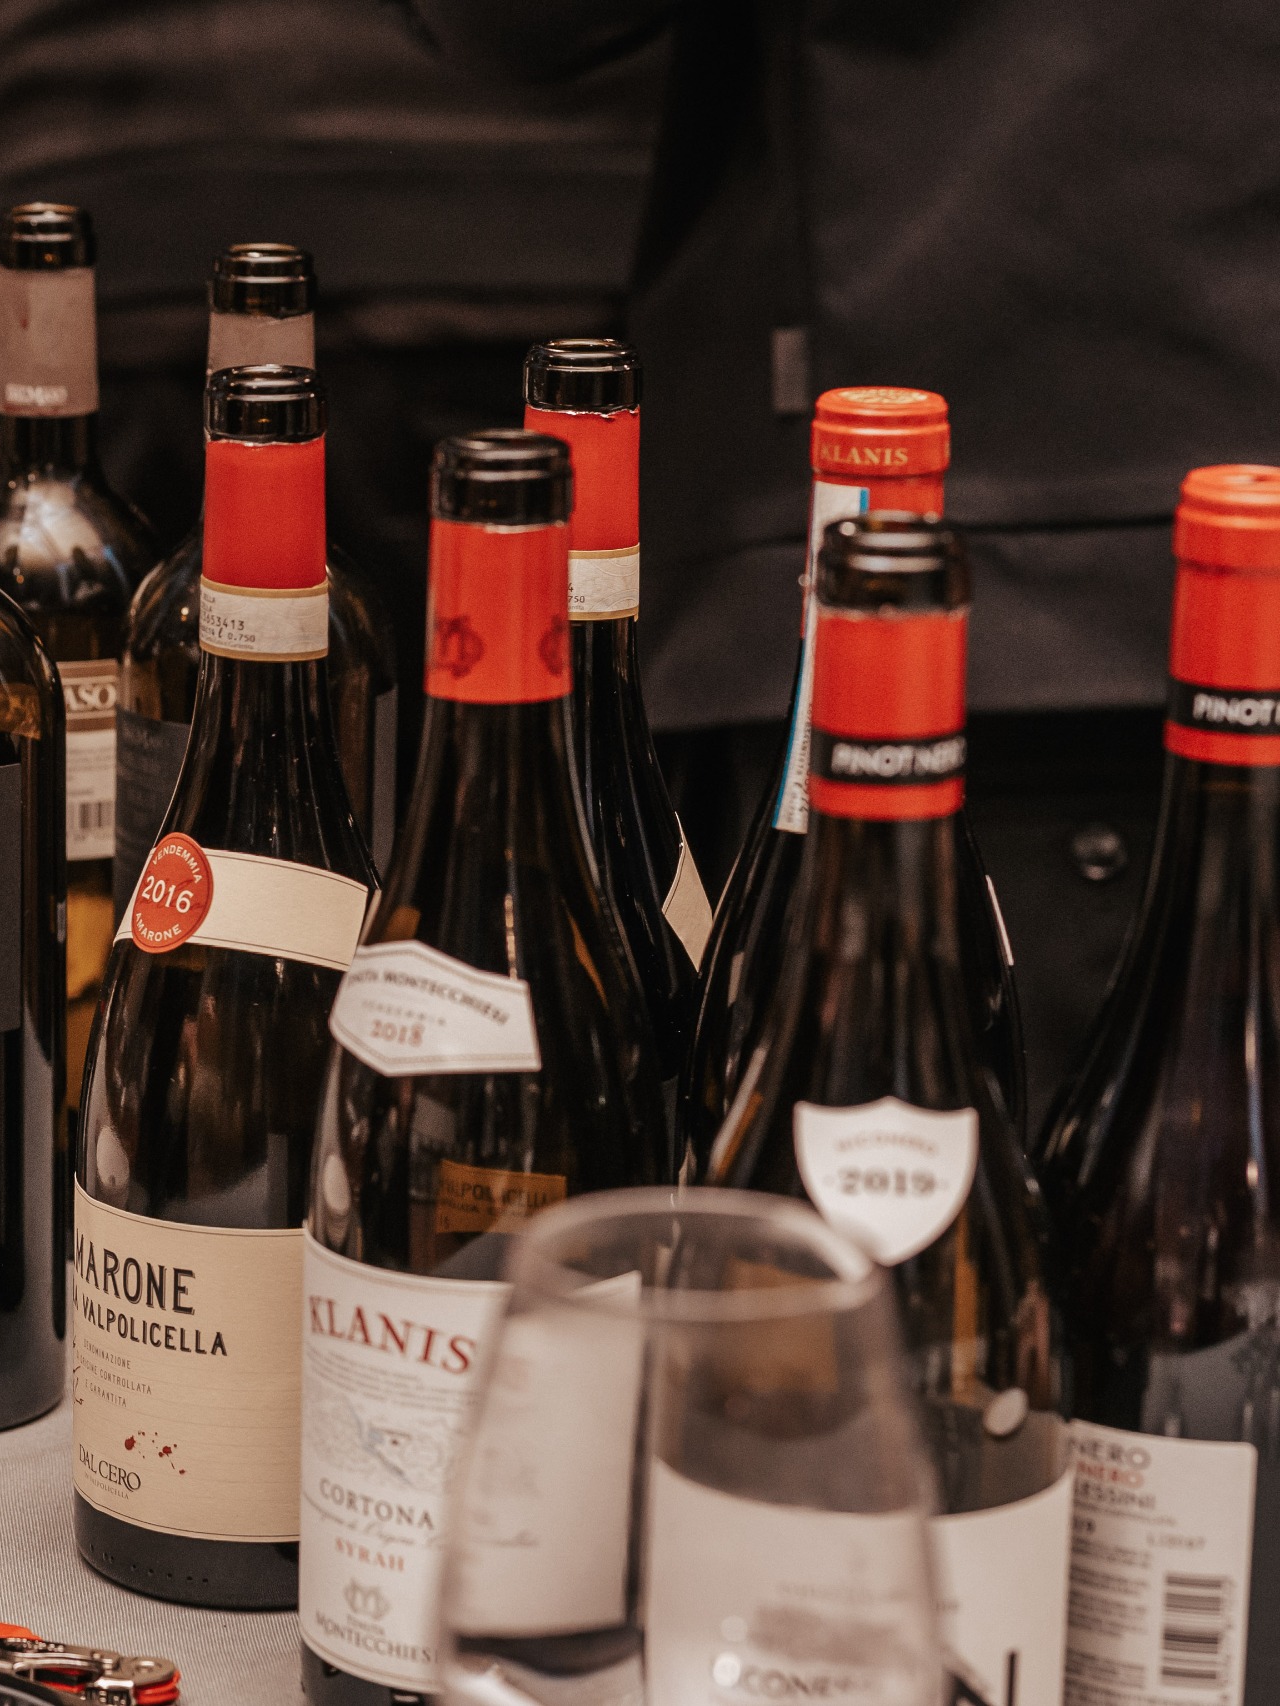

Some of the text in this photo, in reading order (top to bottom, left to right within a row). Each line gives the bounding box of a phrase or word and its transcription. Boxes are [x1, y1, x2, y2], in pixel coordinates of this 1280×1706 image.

[820, 443, 909, 466] KLANIS
[152, 844, 203, 884] VENDEMMIA
[141, 875, 194, 914] 2016
[135, 912, 182, 942] AMARONE
[82, 1292, 228, 1357] VALPOLICELLA
[100, 1368, 152, 1395] CONTROLLATA
[80, 1443, 142, 1492] DAL CERO
[320, 1478, 434, 1531] CORTONA
